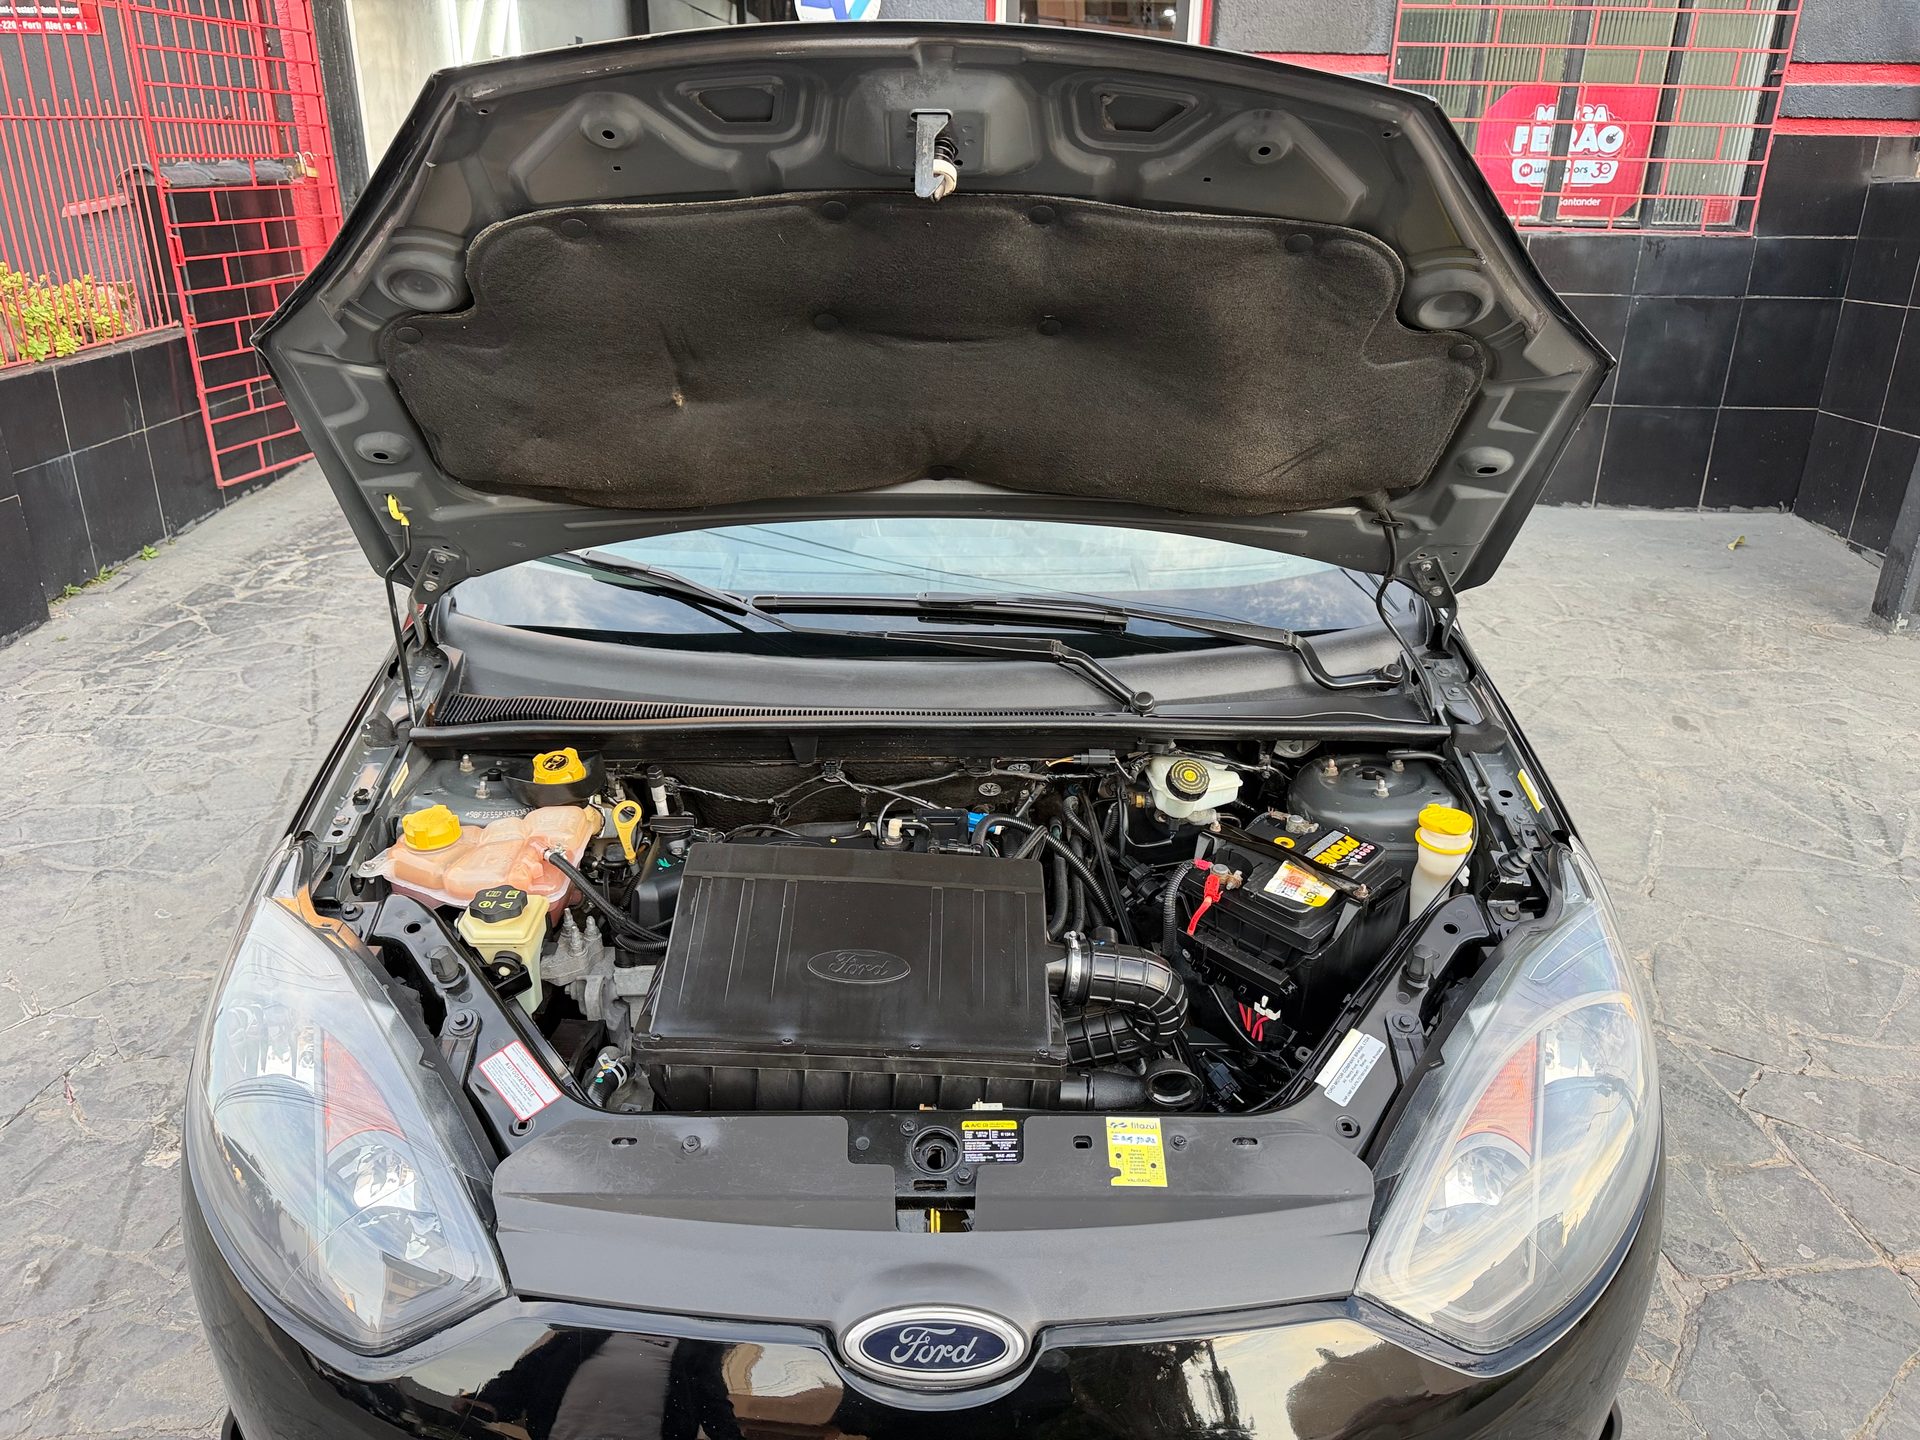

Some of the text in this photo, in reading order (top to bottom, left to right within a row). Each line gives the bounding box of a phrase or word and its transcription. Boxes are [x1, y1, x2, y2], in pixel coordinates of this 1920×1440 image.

[1535, 105, 1608, 123] MGA
[1512, 123, 1625, 153] FERÃO
[1559, 197, 1601, 206] Santander
[1314, 834, 1360, 866] PIONE
[827, 951, 889, 976] Ford
[505, 1062, 535, 1098] AUTODIAGNOSE
[890, 1326, 979, 1363] Ford
